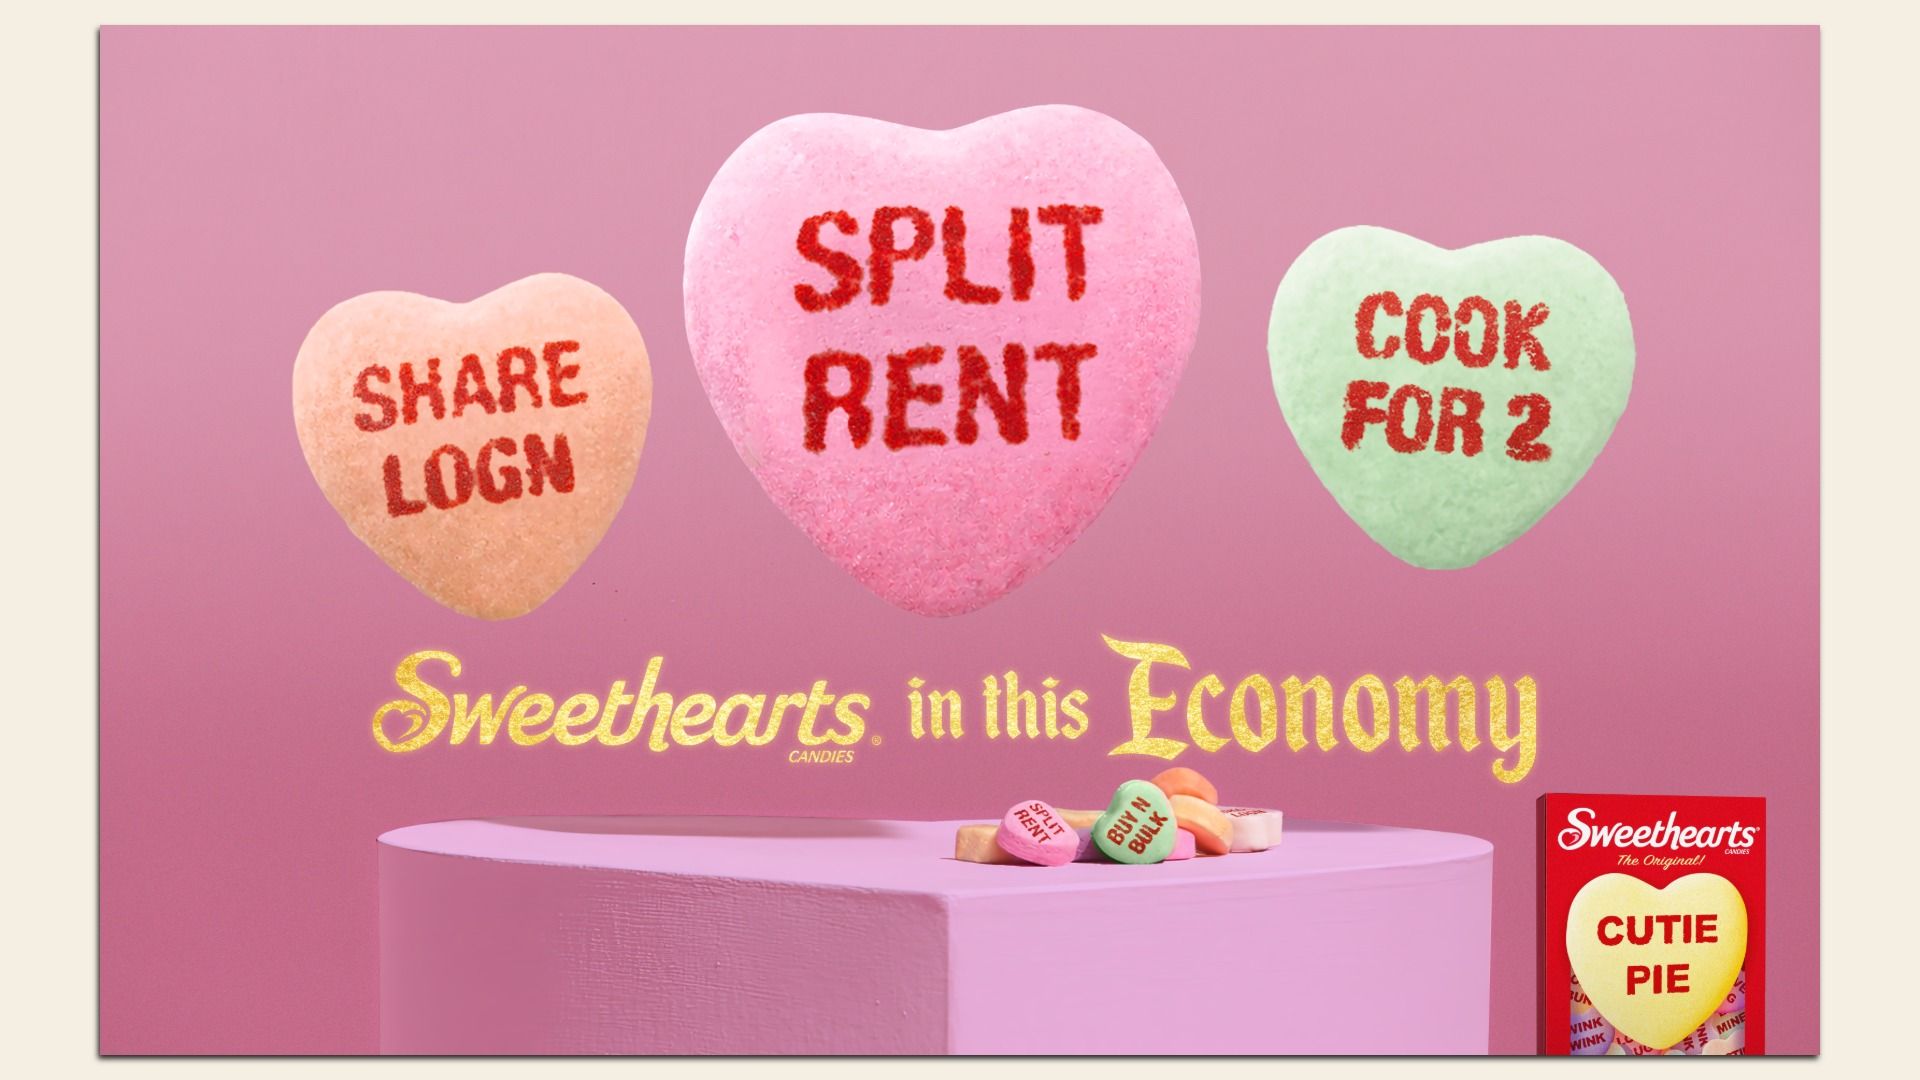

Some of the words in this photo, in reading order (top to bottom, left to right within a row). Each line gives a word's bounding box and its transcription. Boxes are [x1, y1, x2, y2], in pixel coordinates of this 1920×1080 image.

[794, 203, 1103, 312] SPLIT
[1355, 290, 1552, 371] COOK
[353, 340, 588, 432] SHARE
[803, 342, 1098, 453] RENT
[1341, 379, 1485, 457] FOR
[1506, 392, 1553, 463] 2
[383, 433, 575, 517] LOGN
[907, 676, 965, 740] in
[982, 669, 1090, 740] this
[1101, 632, 1537, 784] Economy
[788, 749, 855, 764] CANDIES
[1013, 808, 1051, 844] RENT
[1029, 802, 1065, 836] SPLIT
[1106, 809, 1138, 846] BUY
[1130, 796, 1151, 813] N
[1127, 810, 1169, 855] BULK
[1617, 854, 1639, 866] The
[1643, 854, 1706, 871] Original!
[1597, 914, 1718, 946] CUTIE
[1626, 963, 1690, 996] PIE
